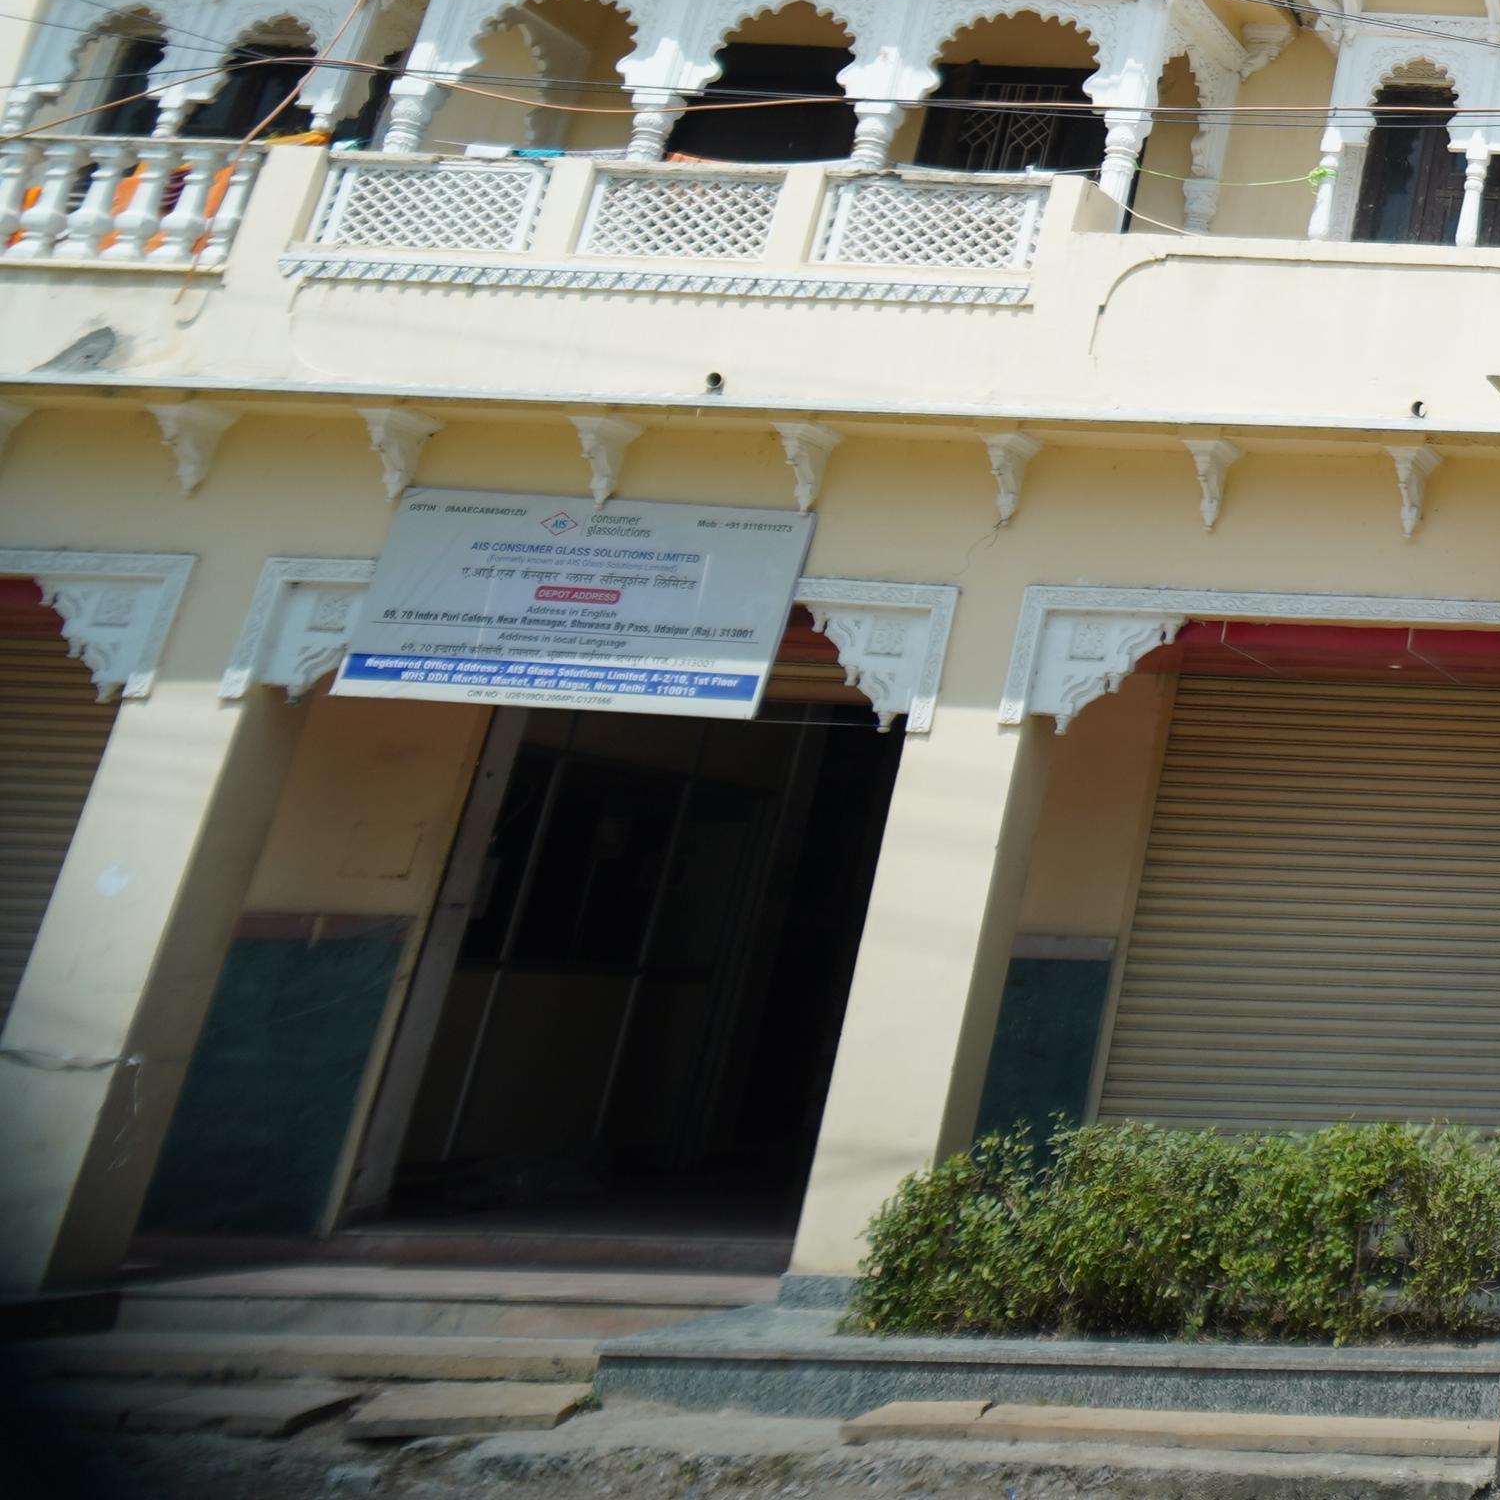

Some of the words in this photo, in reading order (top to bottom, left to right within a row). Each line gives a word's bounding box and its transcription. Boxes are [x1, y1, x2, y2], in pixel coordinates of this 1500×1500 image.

[409, 503, 437, 512] GSTIN
[551, 519, 568, 529] AIS
[591, 514, 642, 526] consumer
[586, 524, 652, 539] glassolutions
[470, 541, 490, 551] AIS
[491, 542, 553, 555] CONSUMER
[555, 546, 592, 557] GLASS
[593, 548, 655, 561] SOLUTIONS
[656, 552, 701, 564] LIMITED
[539, 589, 571, 599] DEPOT
[571, 591, 618, 601] ADDRESS
[526, 605, 566, 616] Address
[580, 608, 618, 620] English
[401, 610, 413, 619] 70
[414, 610, 438, 621] Indra
[440, 612, 460, 622] Puri
[496, 615, 518, 626] Near
[613, 621, 627, 633] By
[653, 625, 689, 637] Udaipur
[718, 628, 755, 640] 313001
[498, 631, 539, 643] Address
[553, 635, 577, 645] local
[578, 636, 627, 650] Language
[364, 657, 421, 670] Registered
[423, 660, 454, 671] Office
[455, 662, 498, 674] Address
[506, 664, 525, 675] AIS
[526, 666, 555, 677] Glass
[557, 667, 605, 679] Solutions
[606, 671, 649, 683] Limited,
[693, 676, 710, 686] 1st
[711, 676, 739, 688] Floor
[426, 672, 449, 683] DDA
[450, 673, 488, 685] Marble
[593, 681, 616, 692] New
[618, 682, 646, 693] Delhi
